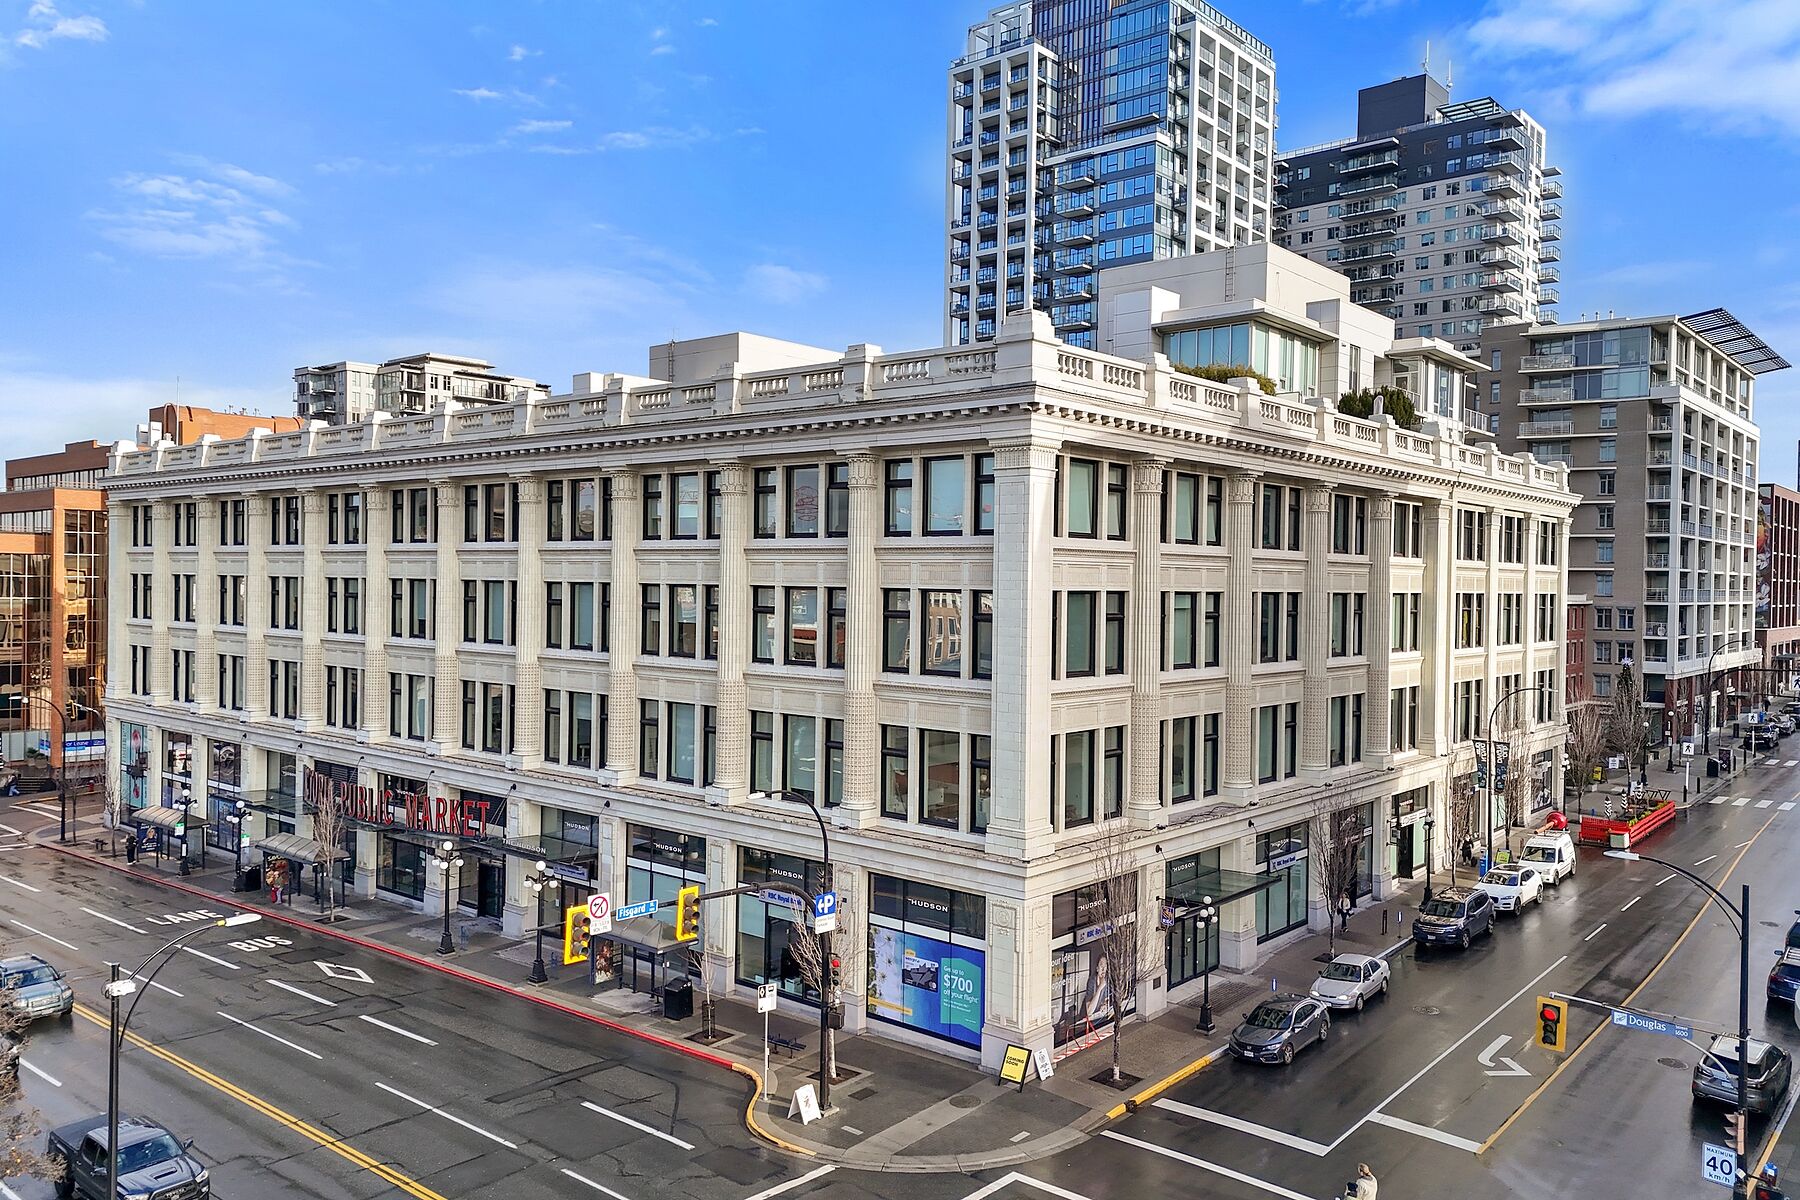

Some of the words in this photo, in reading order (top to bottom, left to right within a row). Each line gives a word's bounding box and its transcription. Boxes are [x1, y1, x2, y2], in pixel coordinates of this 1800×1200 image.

[339, 780, 394, 825] PUBLIC
[405, 794, 490, 838] MARKET
[566, 822, 590, 831] HUDSON
[515, 841, 547, 854] HUDSON
[655, 843, 683, 853] HUDSON
[1173, 861, 1196, 872] HUDSON
[772, 869, 804, 880] HUDSON
[823, 894, 834, 913] P
[911, 900, 948, 912] HUDSON
[619, 903, 646, 918] Fisgard
[145, 909, 224, 926] LANE
[227, 935, 293, 952] BUS
[943, 972, 973, 994] $700
[951, 990, 964, 999] your
[1629, 1015, 1667, 1032] Douglas
[1006, 1055, 1025, 1064] COMING
[1706, 1147, 1733, 1158] MAXIMUM
[1706, 1156, 1733, 1176] 40
[1708, 1172, 1730, 1183] km/h
